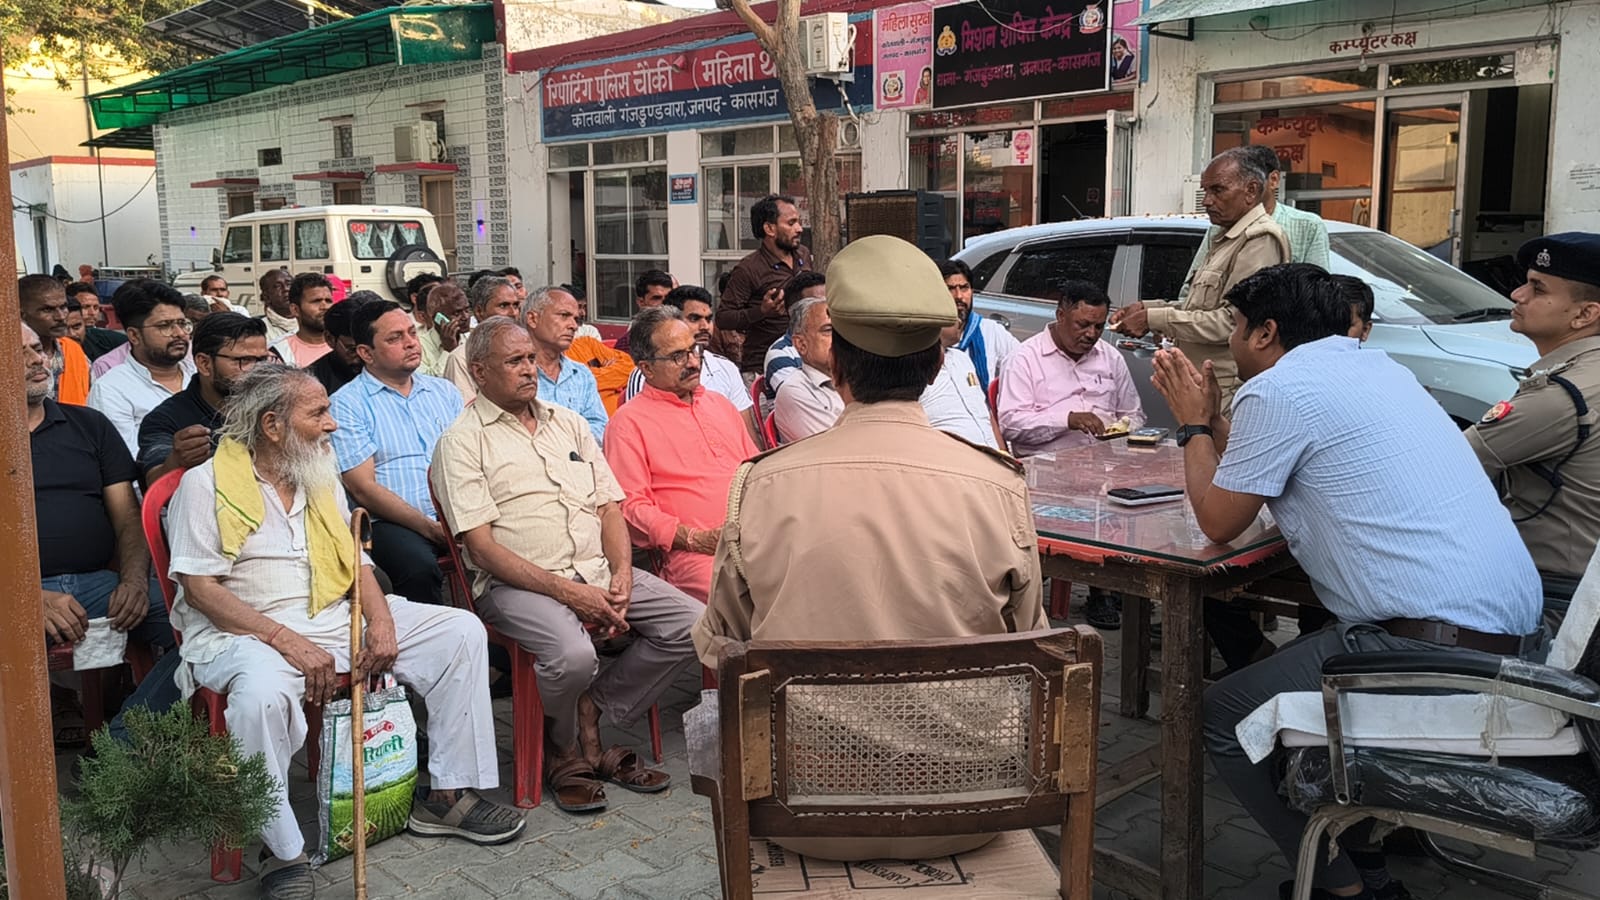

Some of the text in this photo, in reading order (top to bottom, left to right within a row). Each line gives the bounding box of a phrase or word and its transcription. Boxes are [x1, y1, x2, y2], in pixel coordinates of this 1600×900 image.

[881, 12, 909, 32] महिला
[961, 20, 998, 53] मिशन
[1329, 31, 1420, 55] कम्प्यूटर कक्ष
[595, 68, 631, 106] पुलिस
[571, 105, 616, 128] कोतवाली
[729, 85, 779, 110] कासगंज
[363, 734, 404, 764] रियाली
